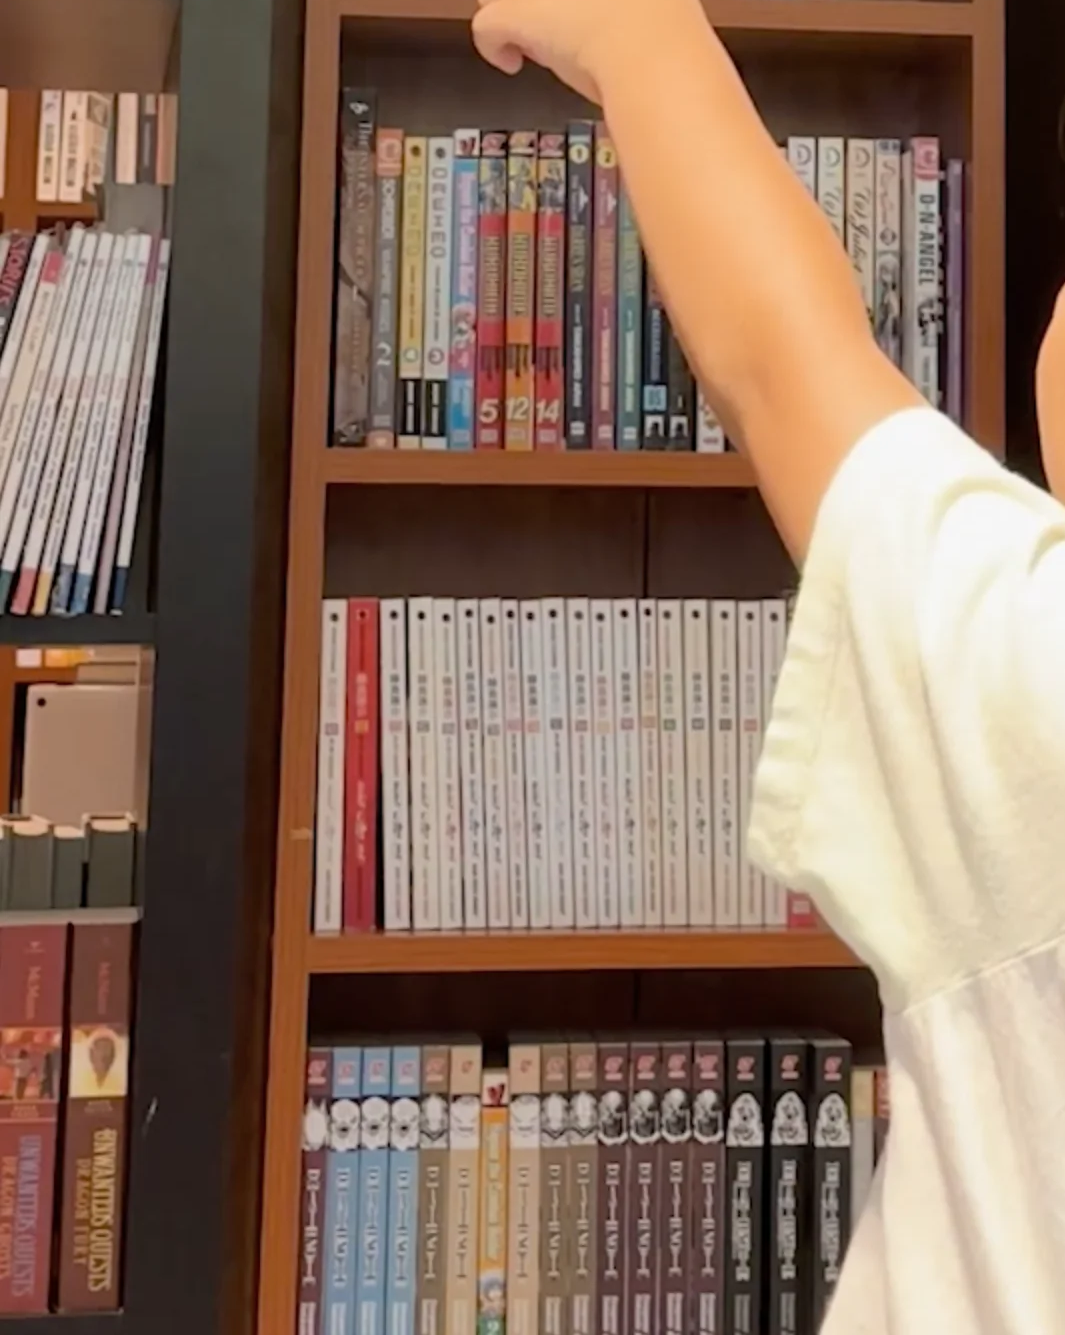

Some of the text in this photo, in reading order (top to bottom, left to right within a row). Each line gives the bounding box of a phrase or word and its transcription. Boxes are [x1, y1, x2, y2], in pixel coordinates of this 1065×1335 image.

[480, 399, 499, 423] 5
[506, 397, 528, 420] 12
[536, 399, 560, 421] 14
[75, 1158, 89, 1219] DRAGON
[88, 1129, 116, 1292] UNWANTEDS QUESTS
